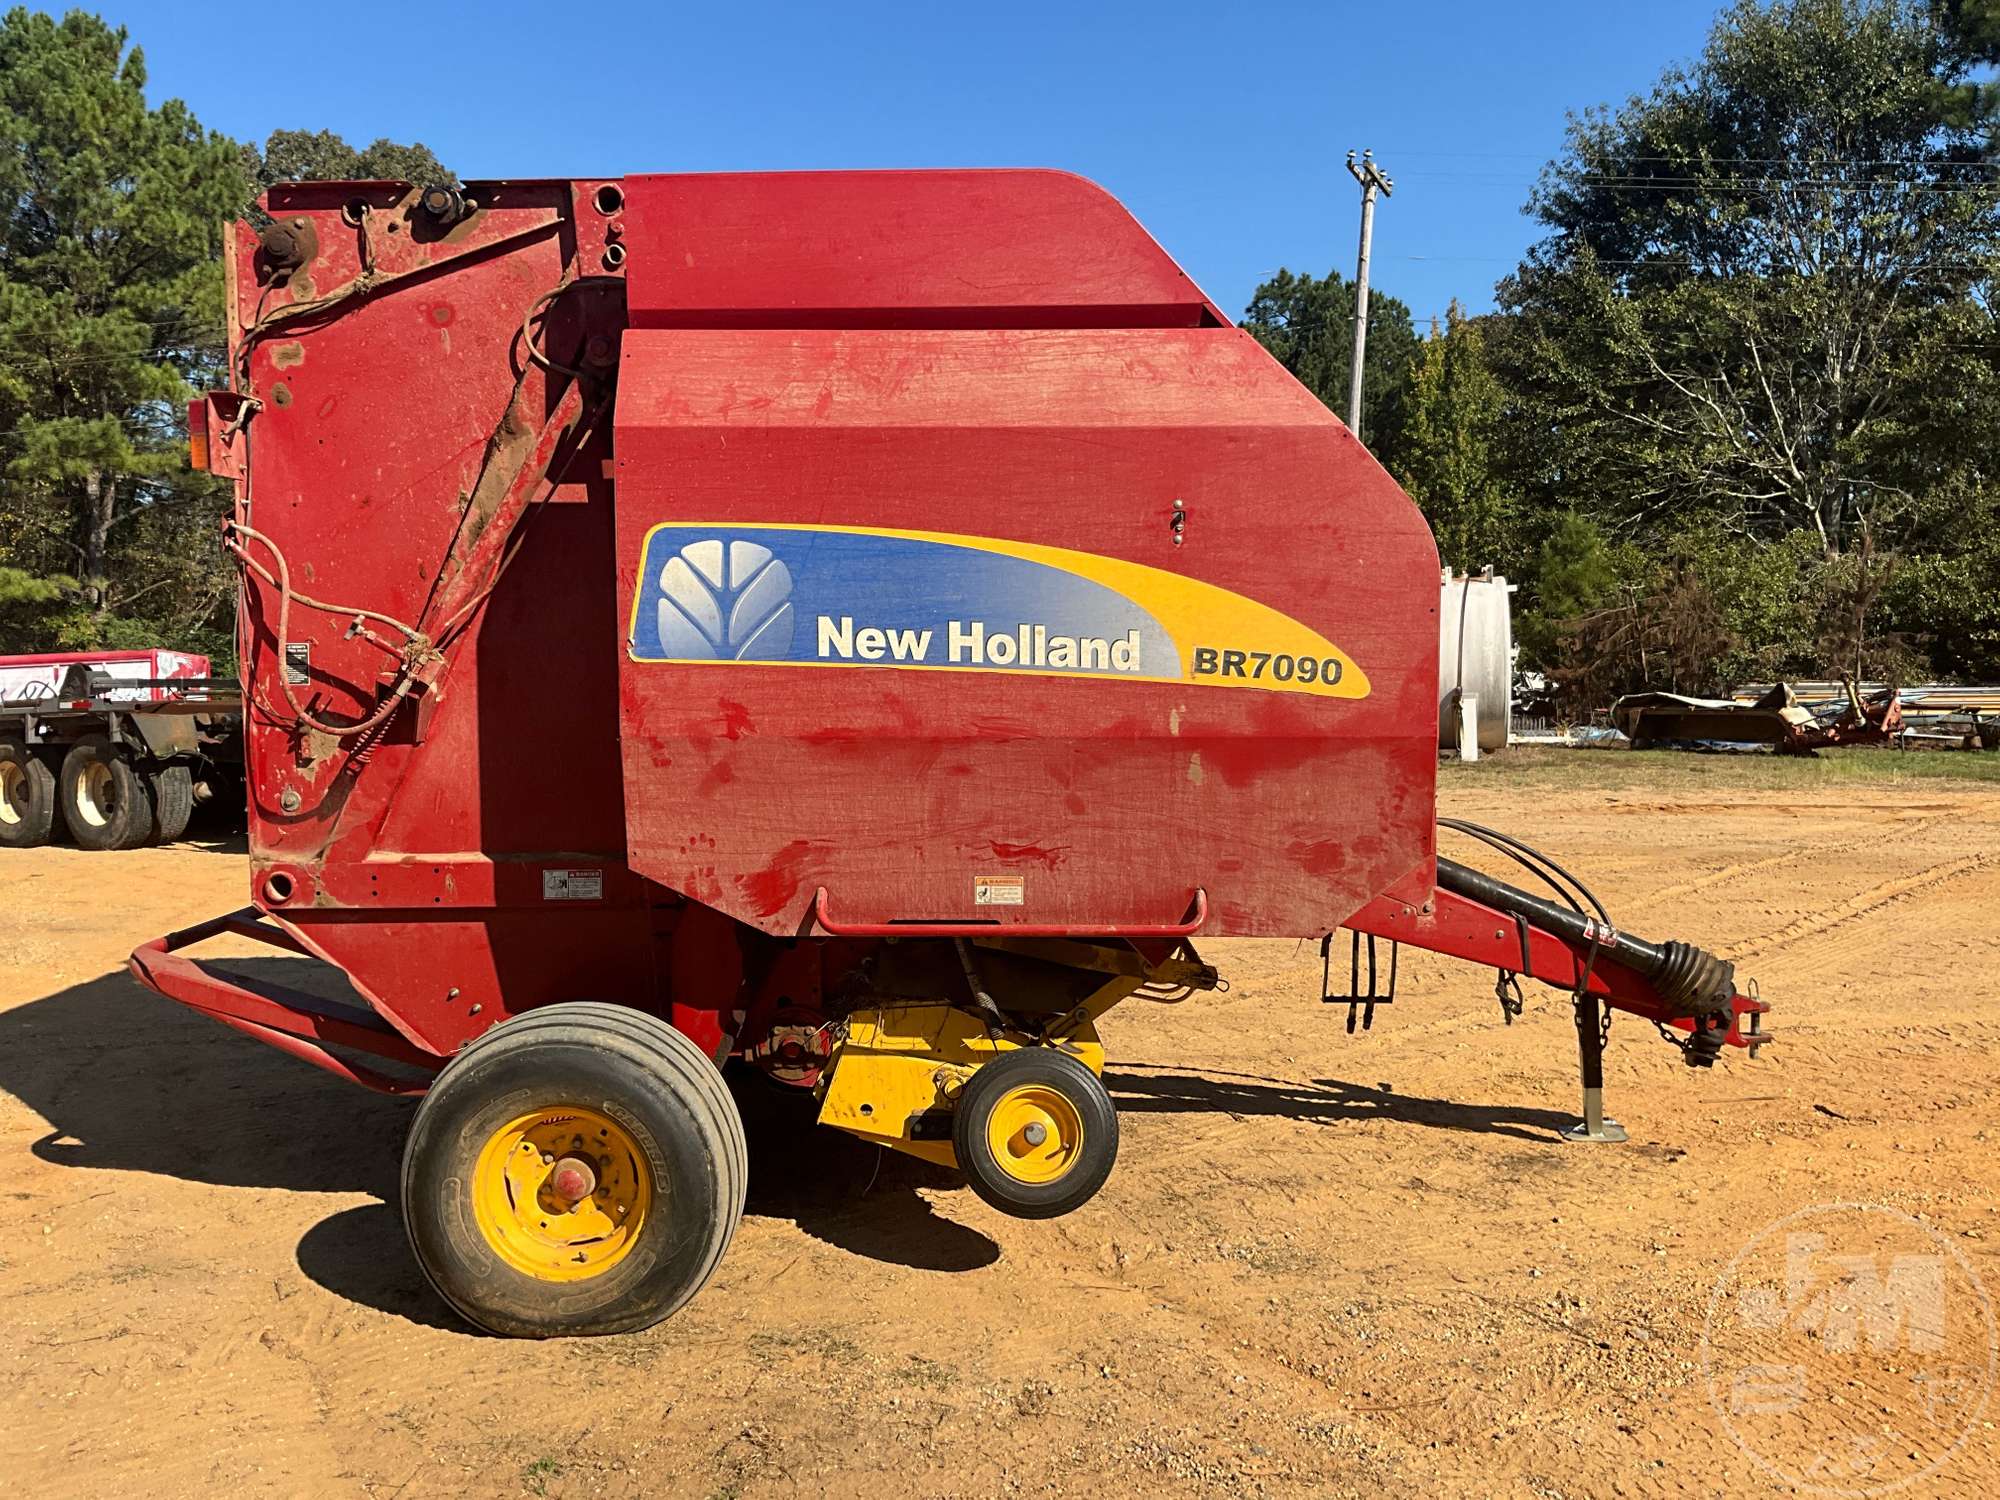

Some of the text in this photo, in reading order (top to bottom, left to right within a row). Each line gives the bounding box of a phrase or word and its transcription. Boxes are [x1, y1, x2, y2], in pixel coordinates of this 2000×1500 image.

[815, 615, 1141, 671] New Holland
[1194, 646, 1343, 686] BR7090
